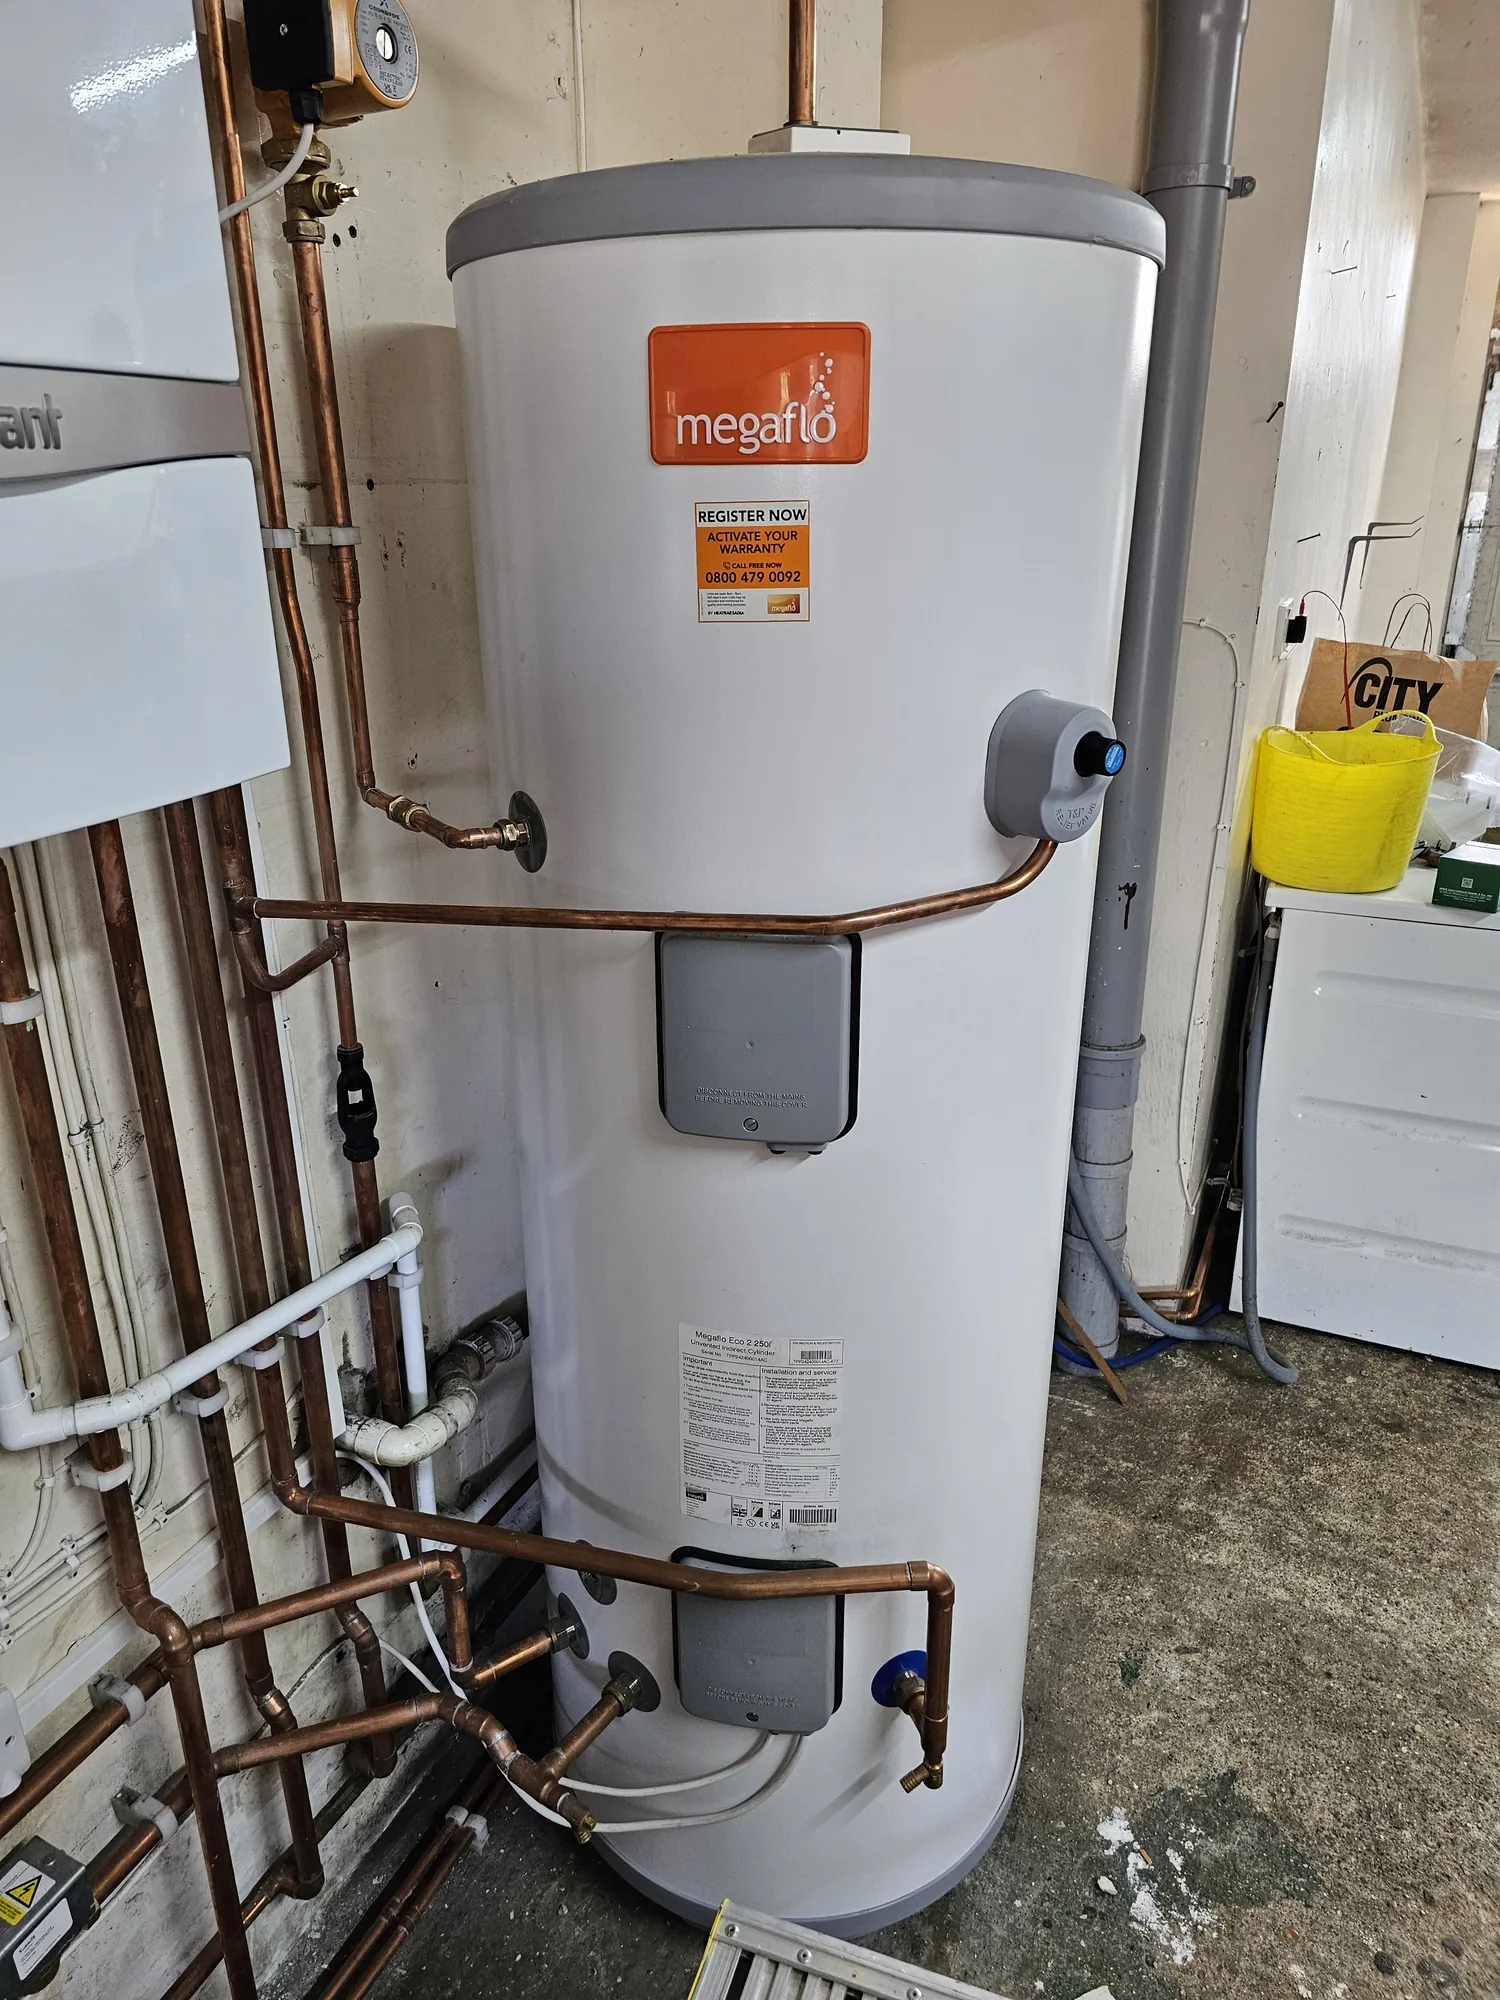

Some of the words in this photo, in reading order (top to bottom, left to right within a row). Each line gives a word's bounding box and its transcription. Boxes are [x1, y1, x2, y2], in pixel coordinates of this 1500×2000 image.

[368, 4, 401, 20] GRUNDFOS
[676, 401, 837, 454] megaflo
[698, 510, 766, 523] REGISTER
[769, 508, 808, 522] NOW
[707, 531, 761, 543] ACTIVATE
[764, 530, 798, 542] YOUR
[719, 543, 785, 555] WARRANTY
[705, 571, 737, 584] 0800
[740, 571, 765, 584] 479
[769, 571, 801, 583] 0092
[1354, 673, 1444, 715] CITY
[696, 1086, 742, 1097] DISCONNECT
[743, 1091, 765, 1099] FROM
[766, 1092, 780, 1100] THE
[694, 1094, 724, 1104] BEFORE
[724, 1097, 762, 1107] REMOVING
[695, 1330, 727, 1343] Megaflo
[728, 1336, 745, 1346] Eco
[690, 1338, 721, 1350] Unvented
[722, 1345, 747, 1354] Indirect
[748, 1348, 776, 1356] Cylinder
[682, 1355, 713, 1366] Important
